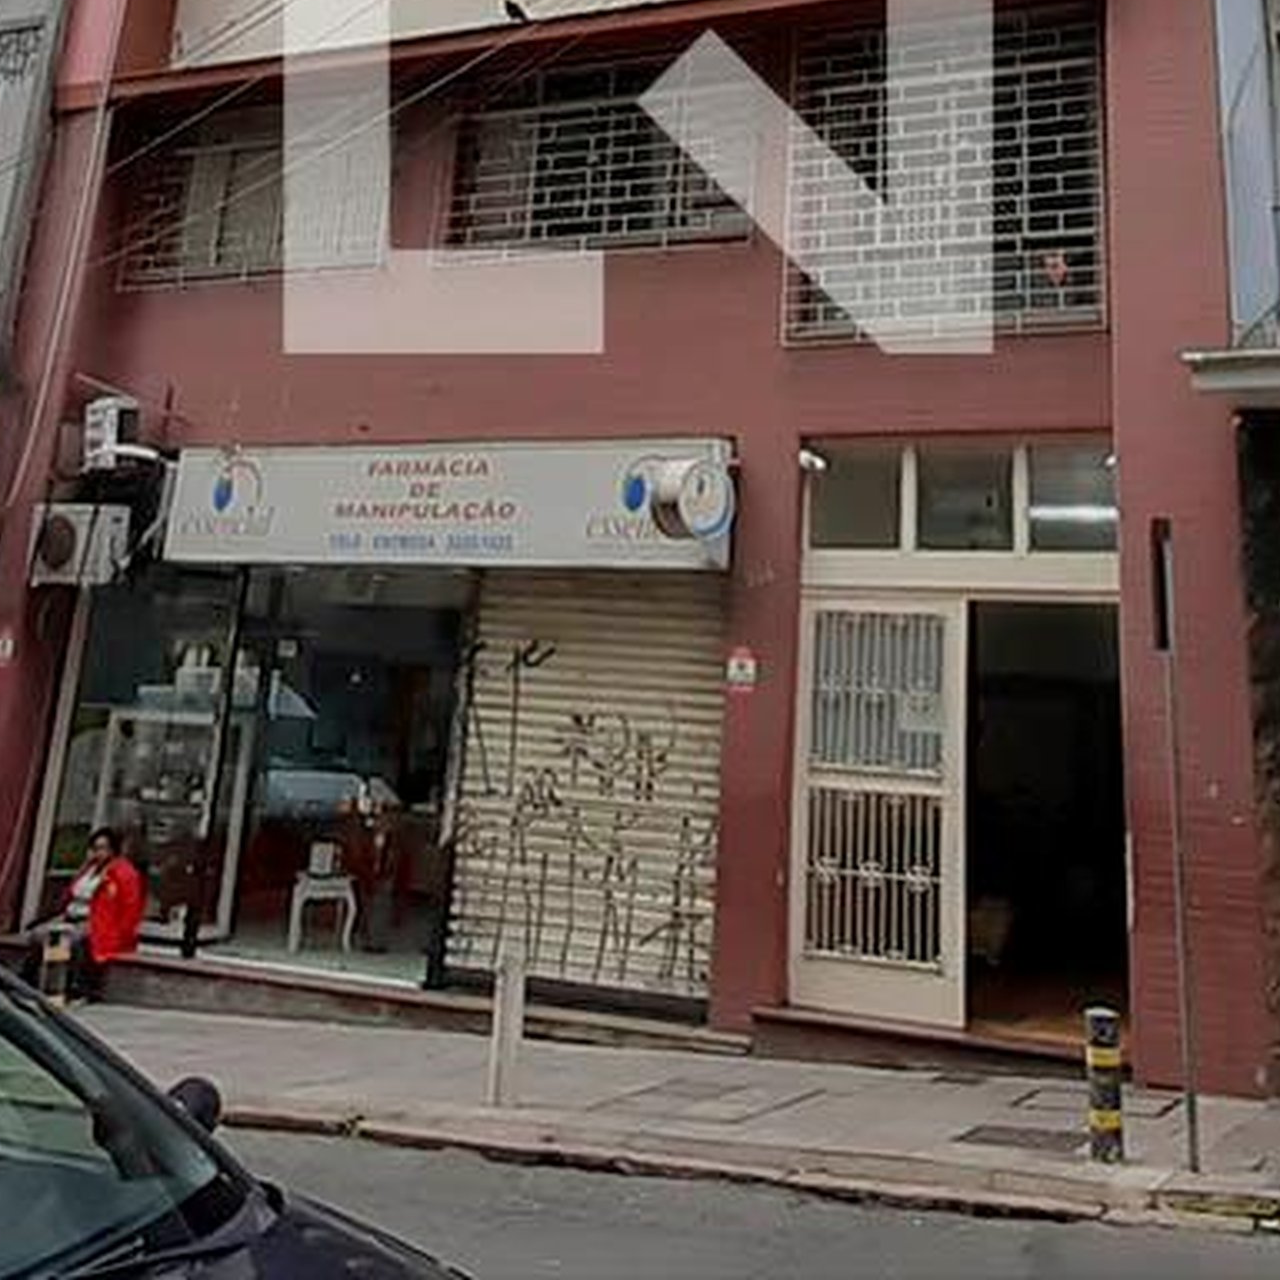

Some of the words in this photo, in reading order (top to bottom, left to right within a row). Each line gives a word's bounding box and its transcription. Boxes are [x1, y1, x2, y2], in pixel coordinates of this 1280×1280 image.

[368, 456, 491, 477] FARMÁCIA
[409, 483, 441, 499] DE
[334, 499, 518, 522] MANIPULAÇÃO
